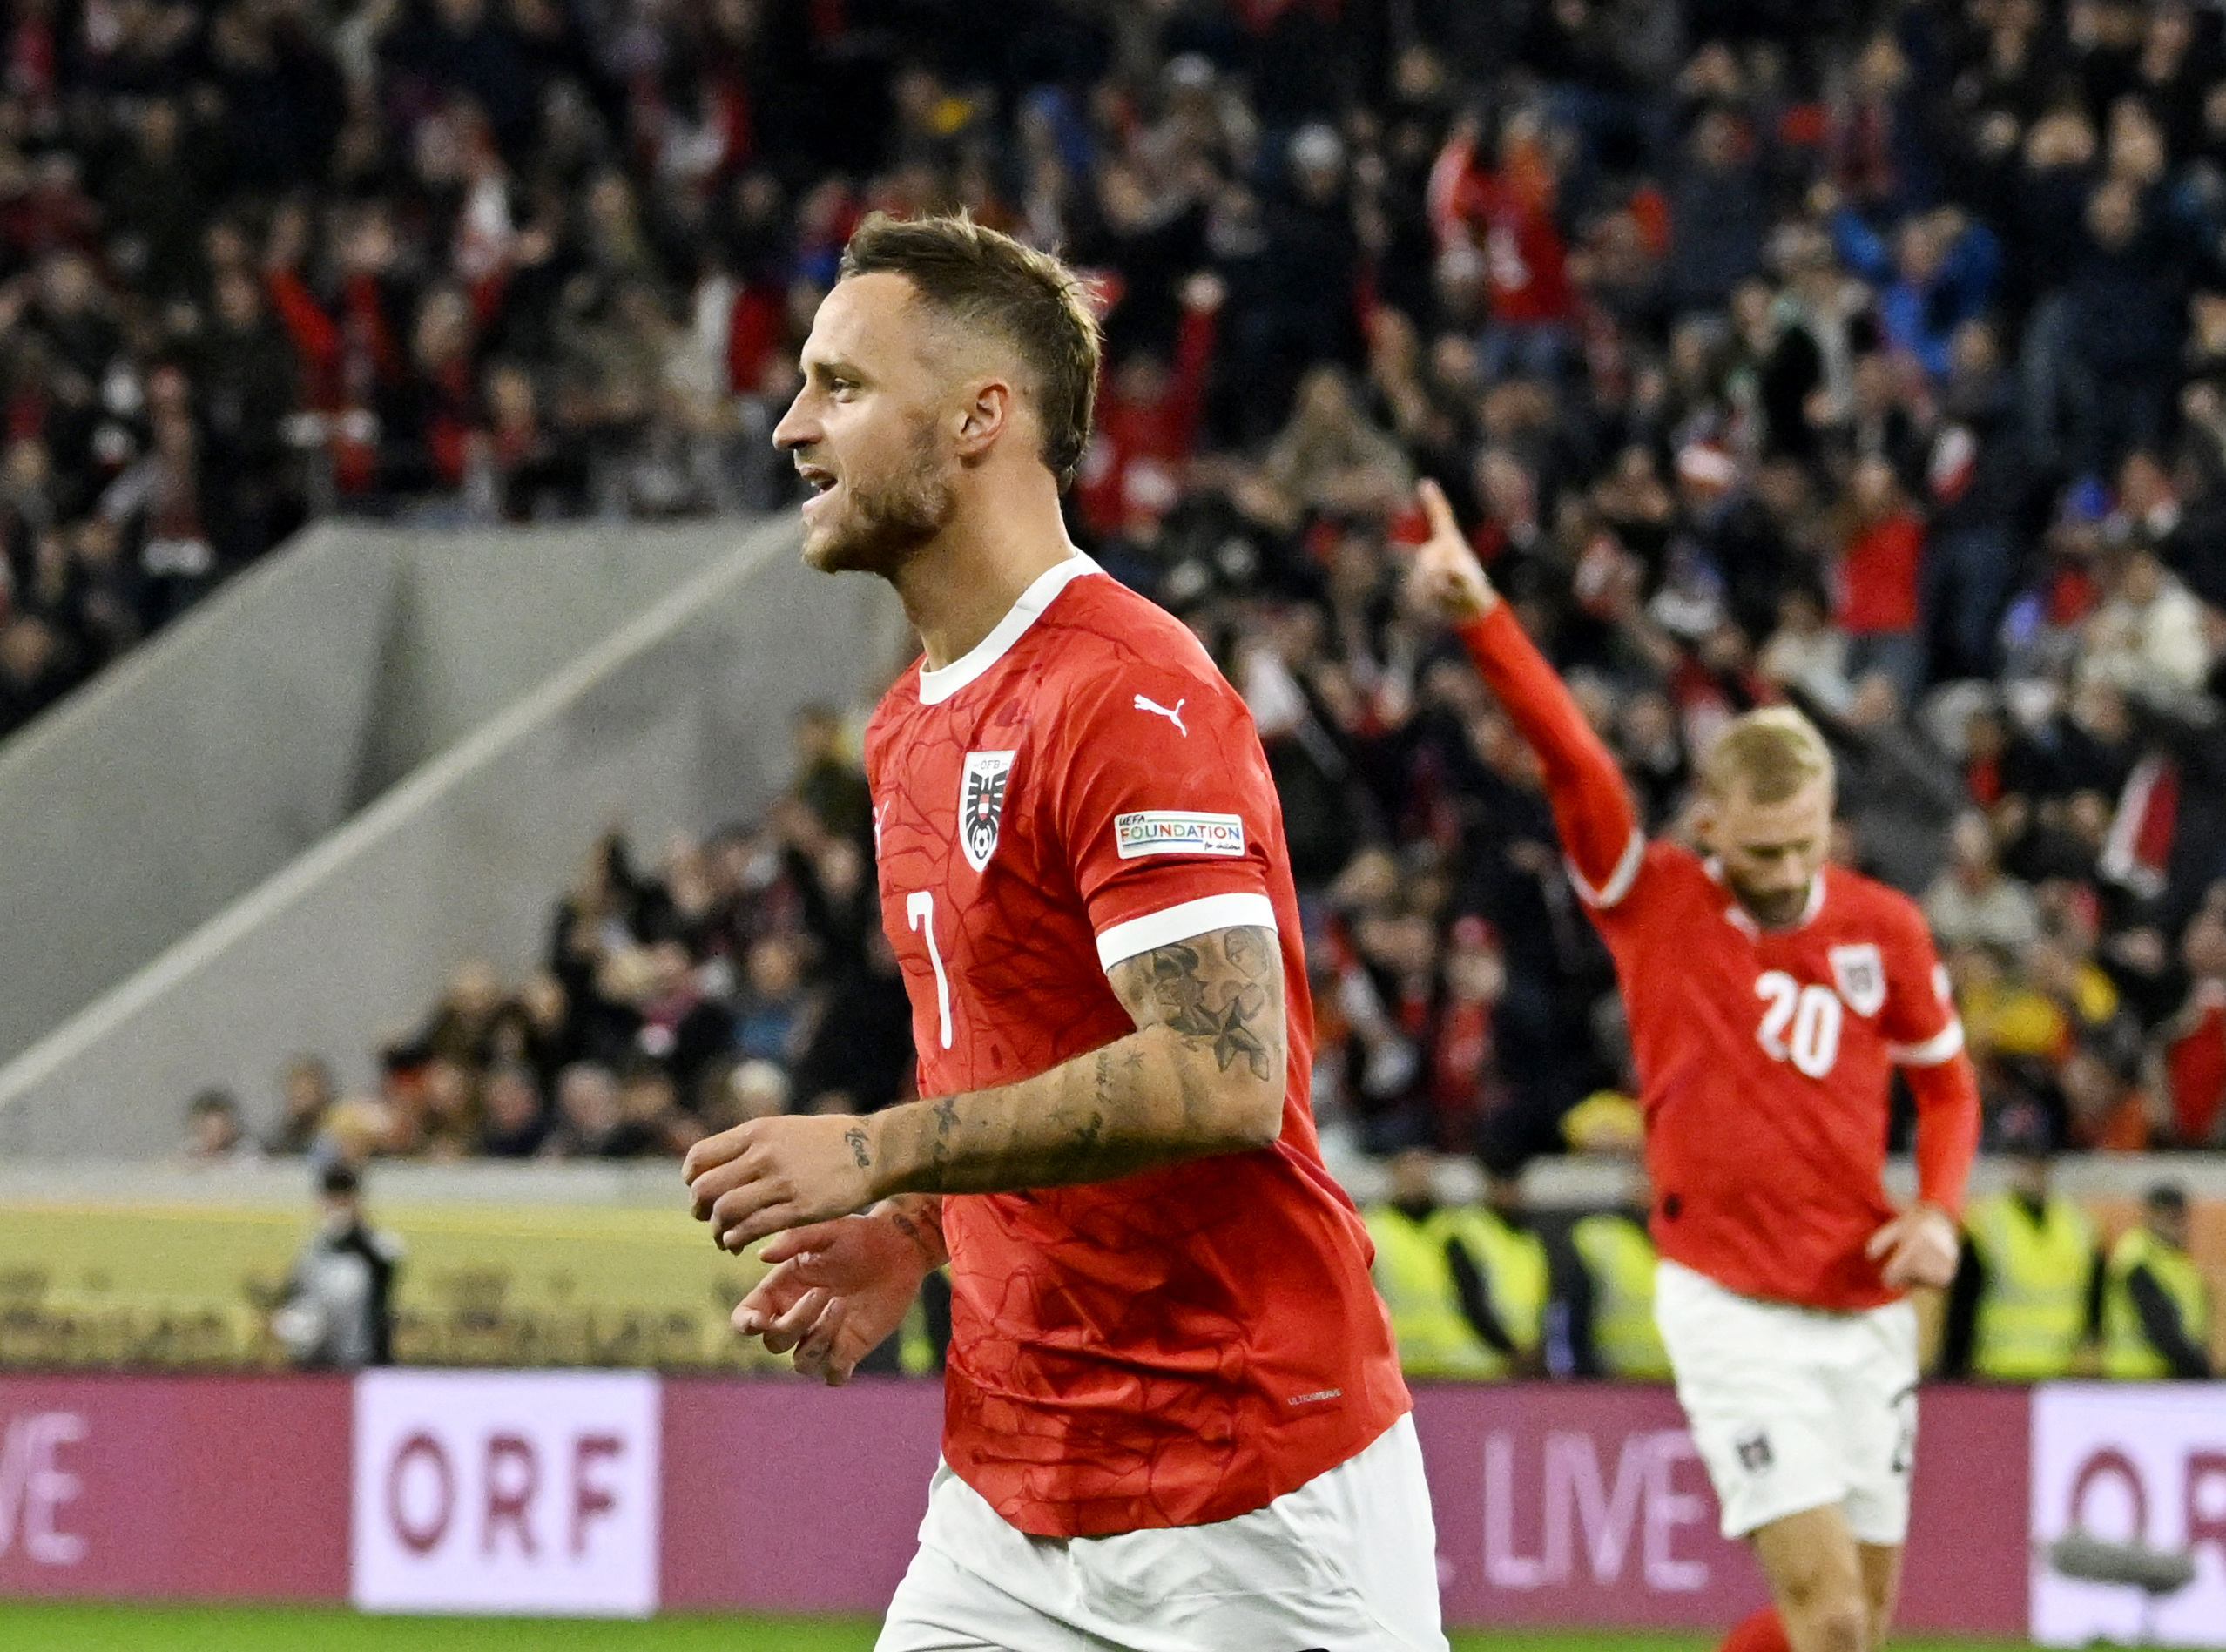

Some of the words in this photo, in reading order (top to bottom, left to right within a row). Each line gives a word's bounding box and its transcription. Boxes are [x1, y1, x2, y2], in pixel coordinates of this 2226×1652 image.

[1118, 814, 1145, 826] UEFA
[1120, 824, 1240, 842] FOUNDATION
[907, 890, 952, 1049] 7
[1754, 969, 1842, 1078] 20
[387, 1430, 626, 1558] ORF
[1484, 1428, 1710, 1591] LIVE
